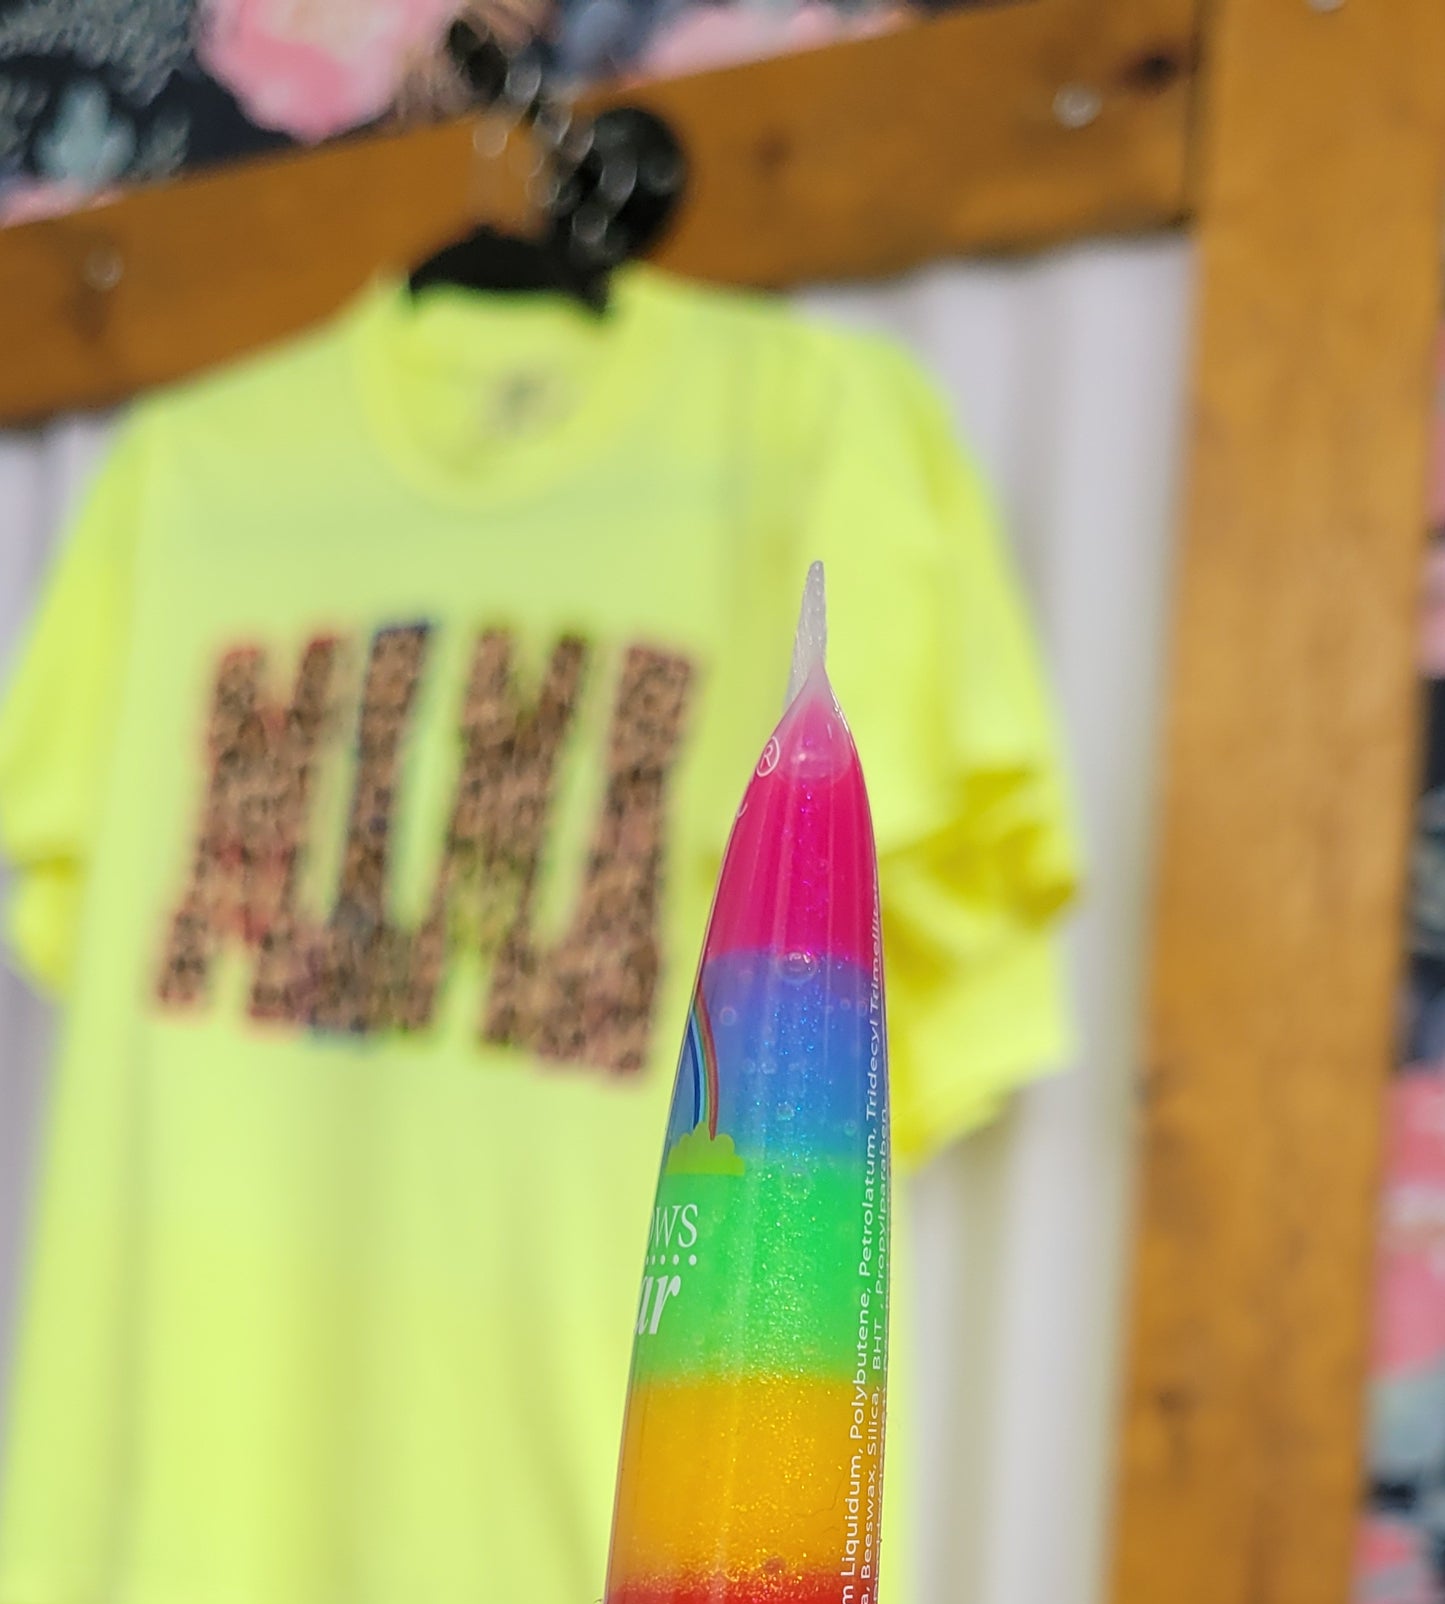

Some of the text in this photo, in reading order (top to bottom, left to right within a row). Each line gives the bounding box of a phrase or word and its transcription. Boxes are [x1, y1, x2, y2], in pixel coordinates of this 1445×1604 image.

[865, 1020, 880, 1121] Tridecyl
[859, 1128, 877, 1277] Petrolatum,
[849, 1287, 871, 1440] Polybutene,
[867, 1385, 880, 1456] Silica,
[840, 1447, 863, 1577] Liquidum,
[861, 1463, 877, 1580] Beeswax,
